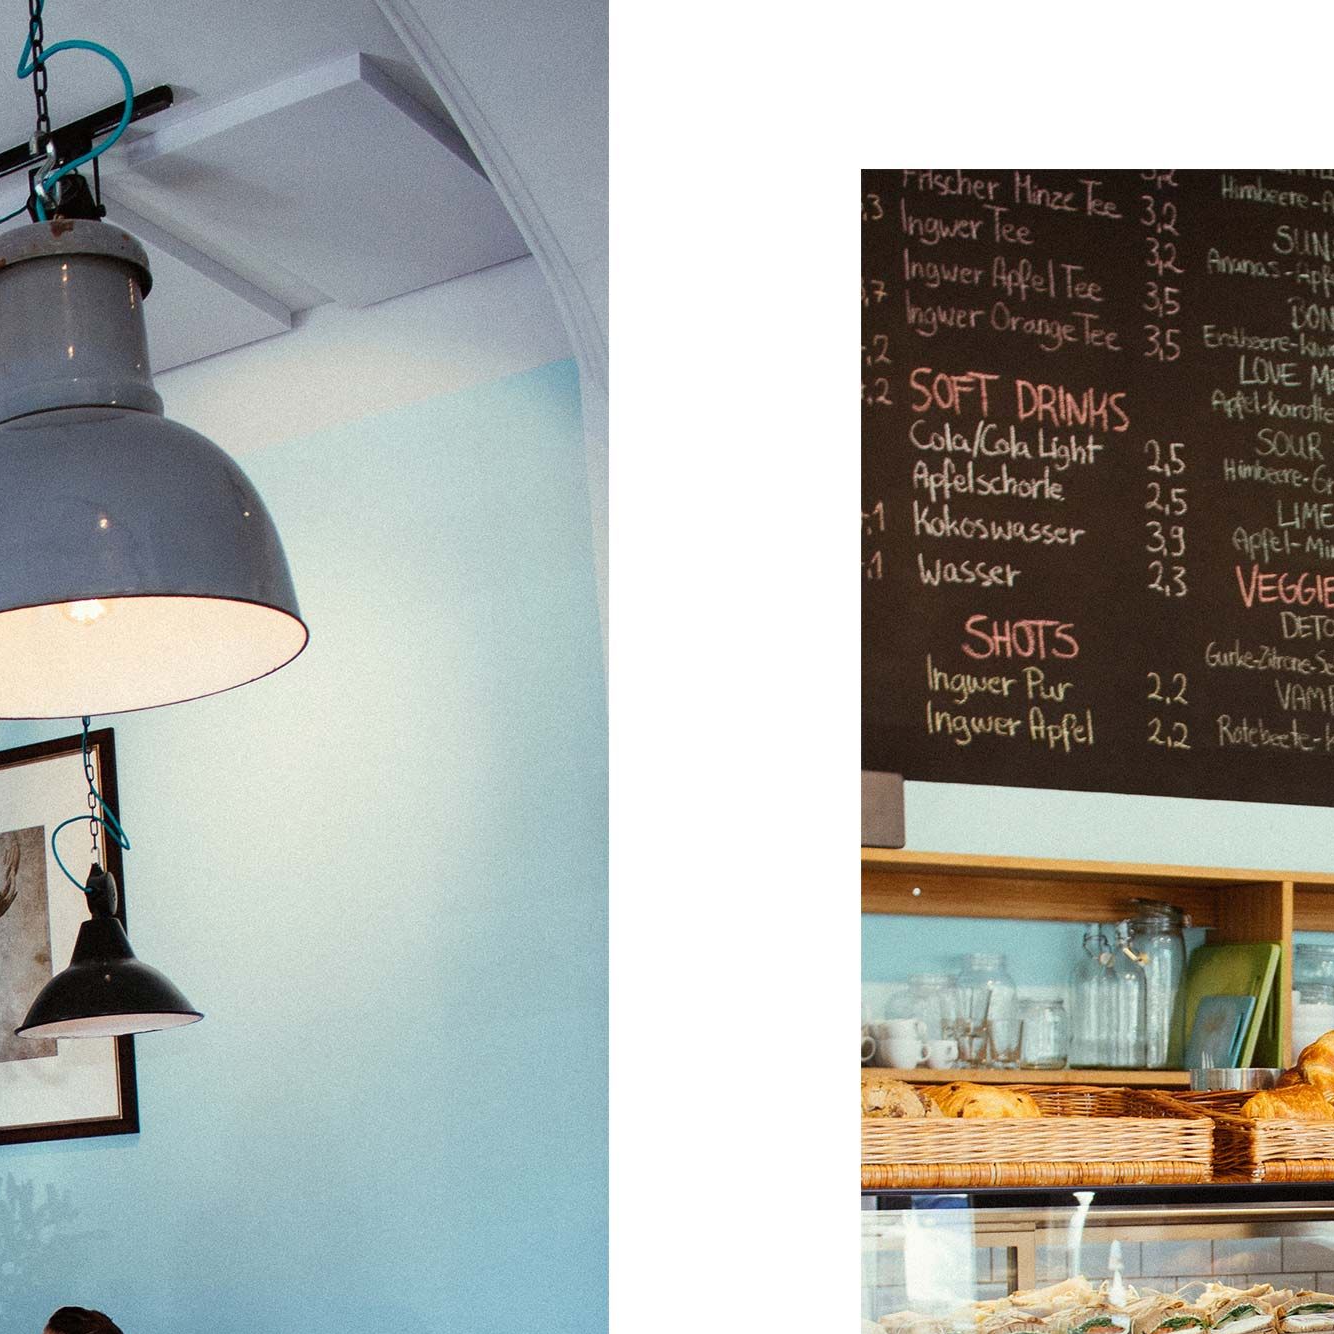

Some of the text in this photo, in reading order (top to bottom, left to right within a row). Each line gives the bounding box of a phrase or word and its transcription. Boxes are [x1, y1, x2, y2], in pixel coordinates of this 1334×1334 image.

[1079, 179, 1123, 219] Tee
[1140, 195, 1180, 236] 3,2
[900, 197, 1185, 276] Ingwer Tee 3,2
[903, 248, 1182, 318] Ingwer Apfel Tee 3,5
[905, 288, 1182, 362] Ingwer Orange Tee 3,5
[1238, 354, 1302, 386] LOVE
[909, 366, 1131, 433] SOFT DRINKS
[908, 419, 1187, 477] Cola/Cola Light 2,5
[1255, 428, 1325, 461] SOUR
[913, 457, 1188, 517] Apfelschorle 2,5
[913, 500, 1186, 558] Kokoswasser 3,9
[917, 552, 1189, 597] Wasser 2,3
[961, 613, 1081, 660] SHOTS
[925, 653, 1189, 706] Ingwer Pur 2,2
[925, 700, 1192, 753] Ingwer Apfel 2,2
